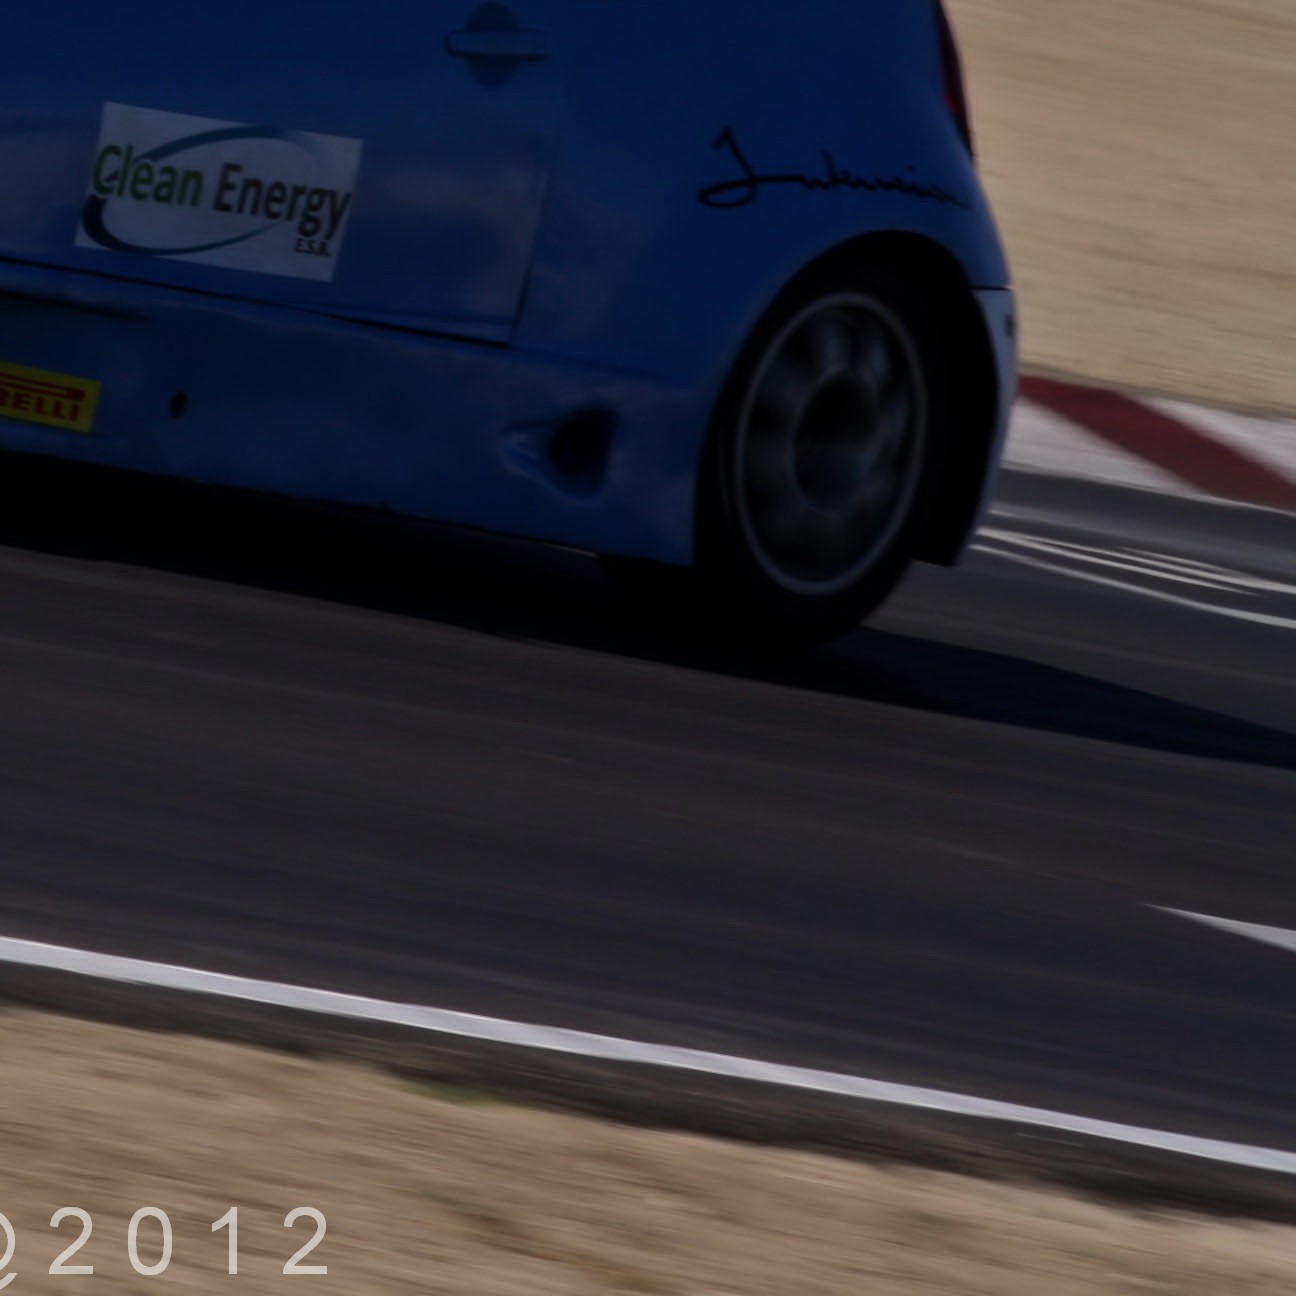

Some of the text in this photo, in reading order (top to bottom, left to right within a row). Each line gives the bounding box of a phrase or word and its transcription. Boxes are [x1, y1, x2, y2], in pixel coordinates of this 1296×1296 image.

[92, 144, 353, 241] Clean Energy
[294, 238, 330, 256] E.S.B.
